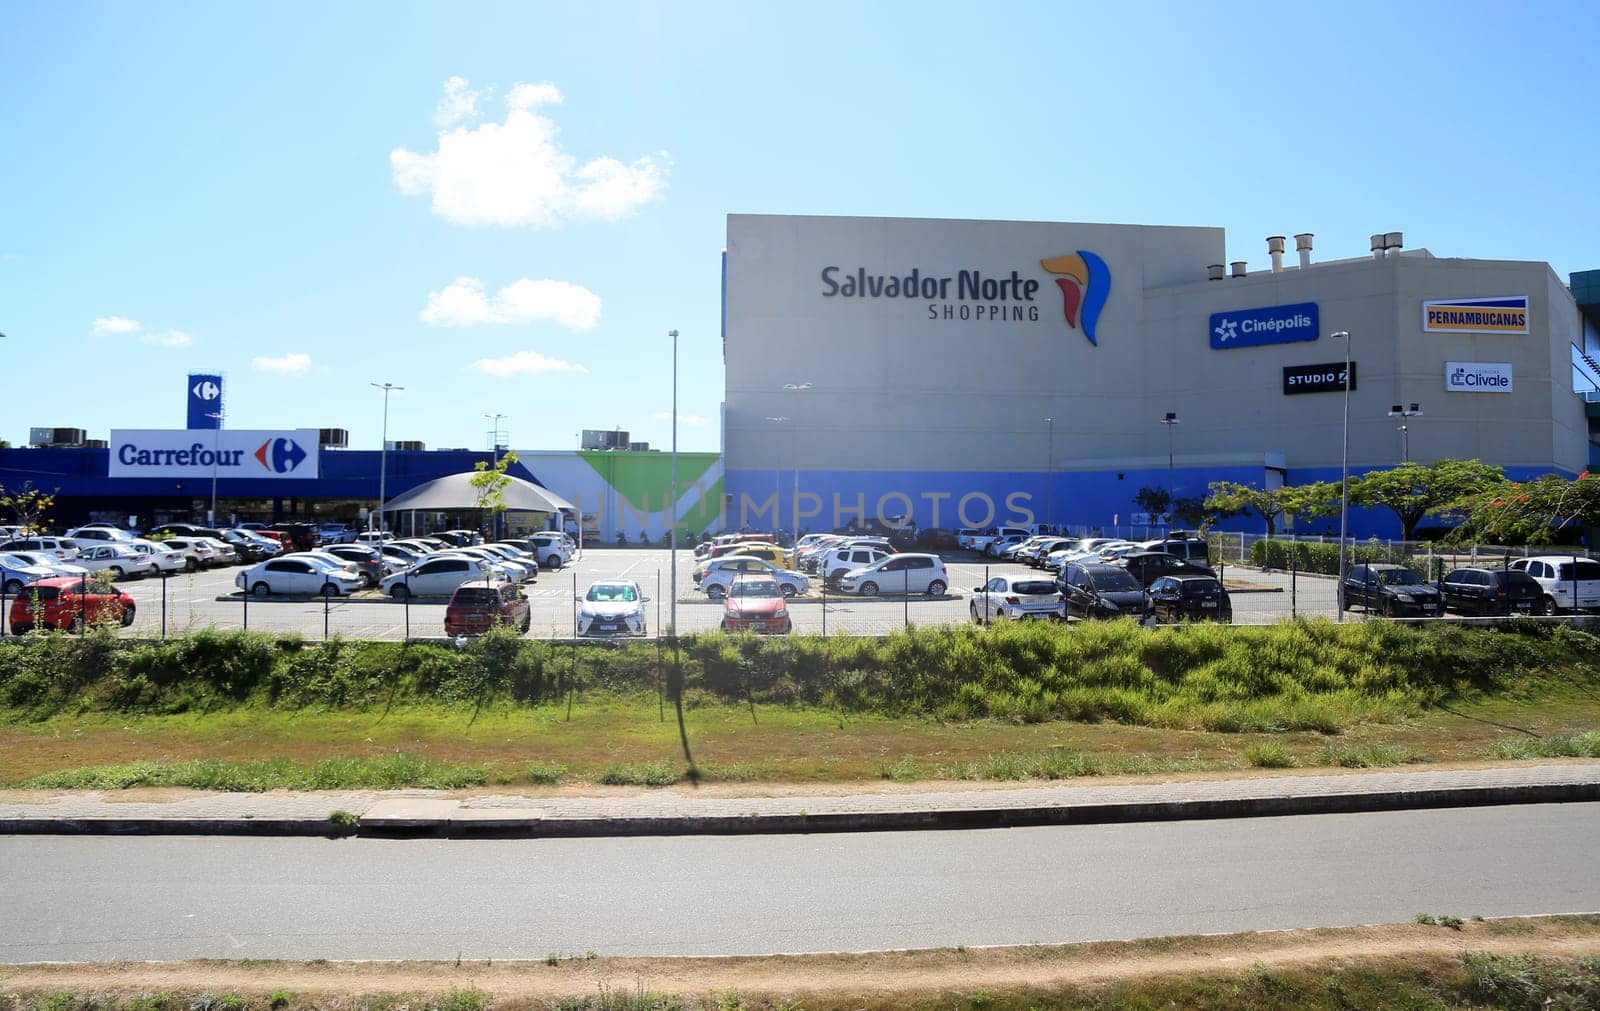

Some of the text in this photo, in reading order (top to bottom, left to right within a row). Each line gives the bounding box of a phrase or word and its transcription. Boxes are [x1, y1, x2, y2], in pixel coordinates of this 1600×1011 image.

[822, 266, 1039, 301] Salvador Norte
[928, 304, 1039, 322] SHOPPING
[1428, 310, 1526, 328] PERNAMBUCANAS
[1241, 313, 1312, 334] Cinépolis
[1288, 372, 1335, 385] STUDIO
[1465, 373, 1509, 387] Clivale
[118, 443, 244, 466] Carrefour
